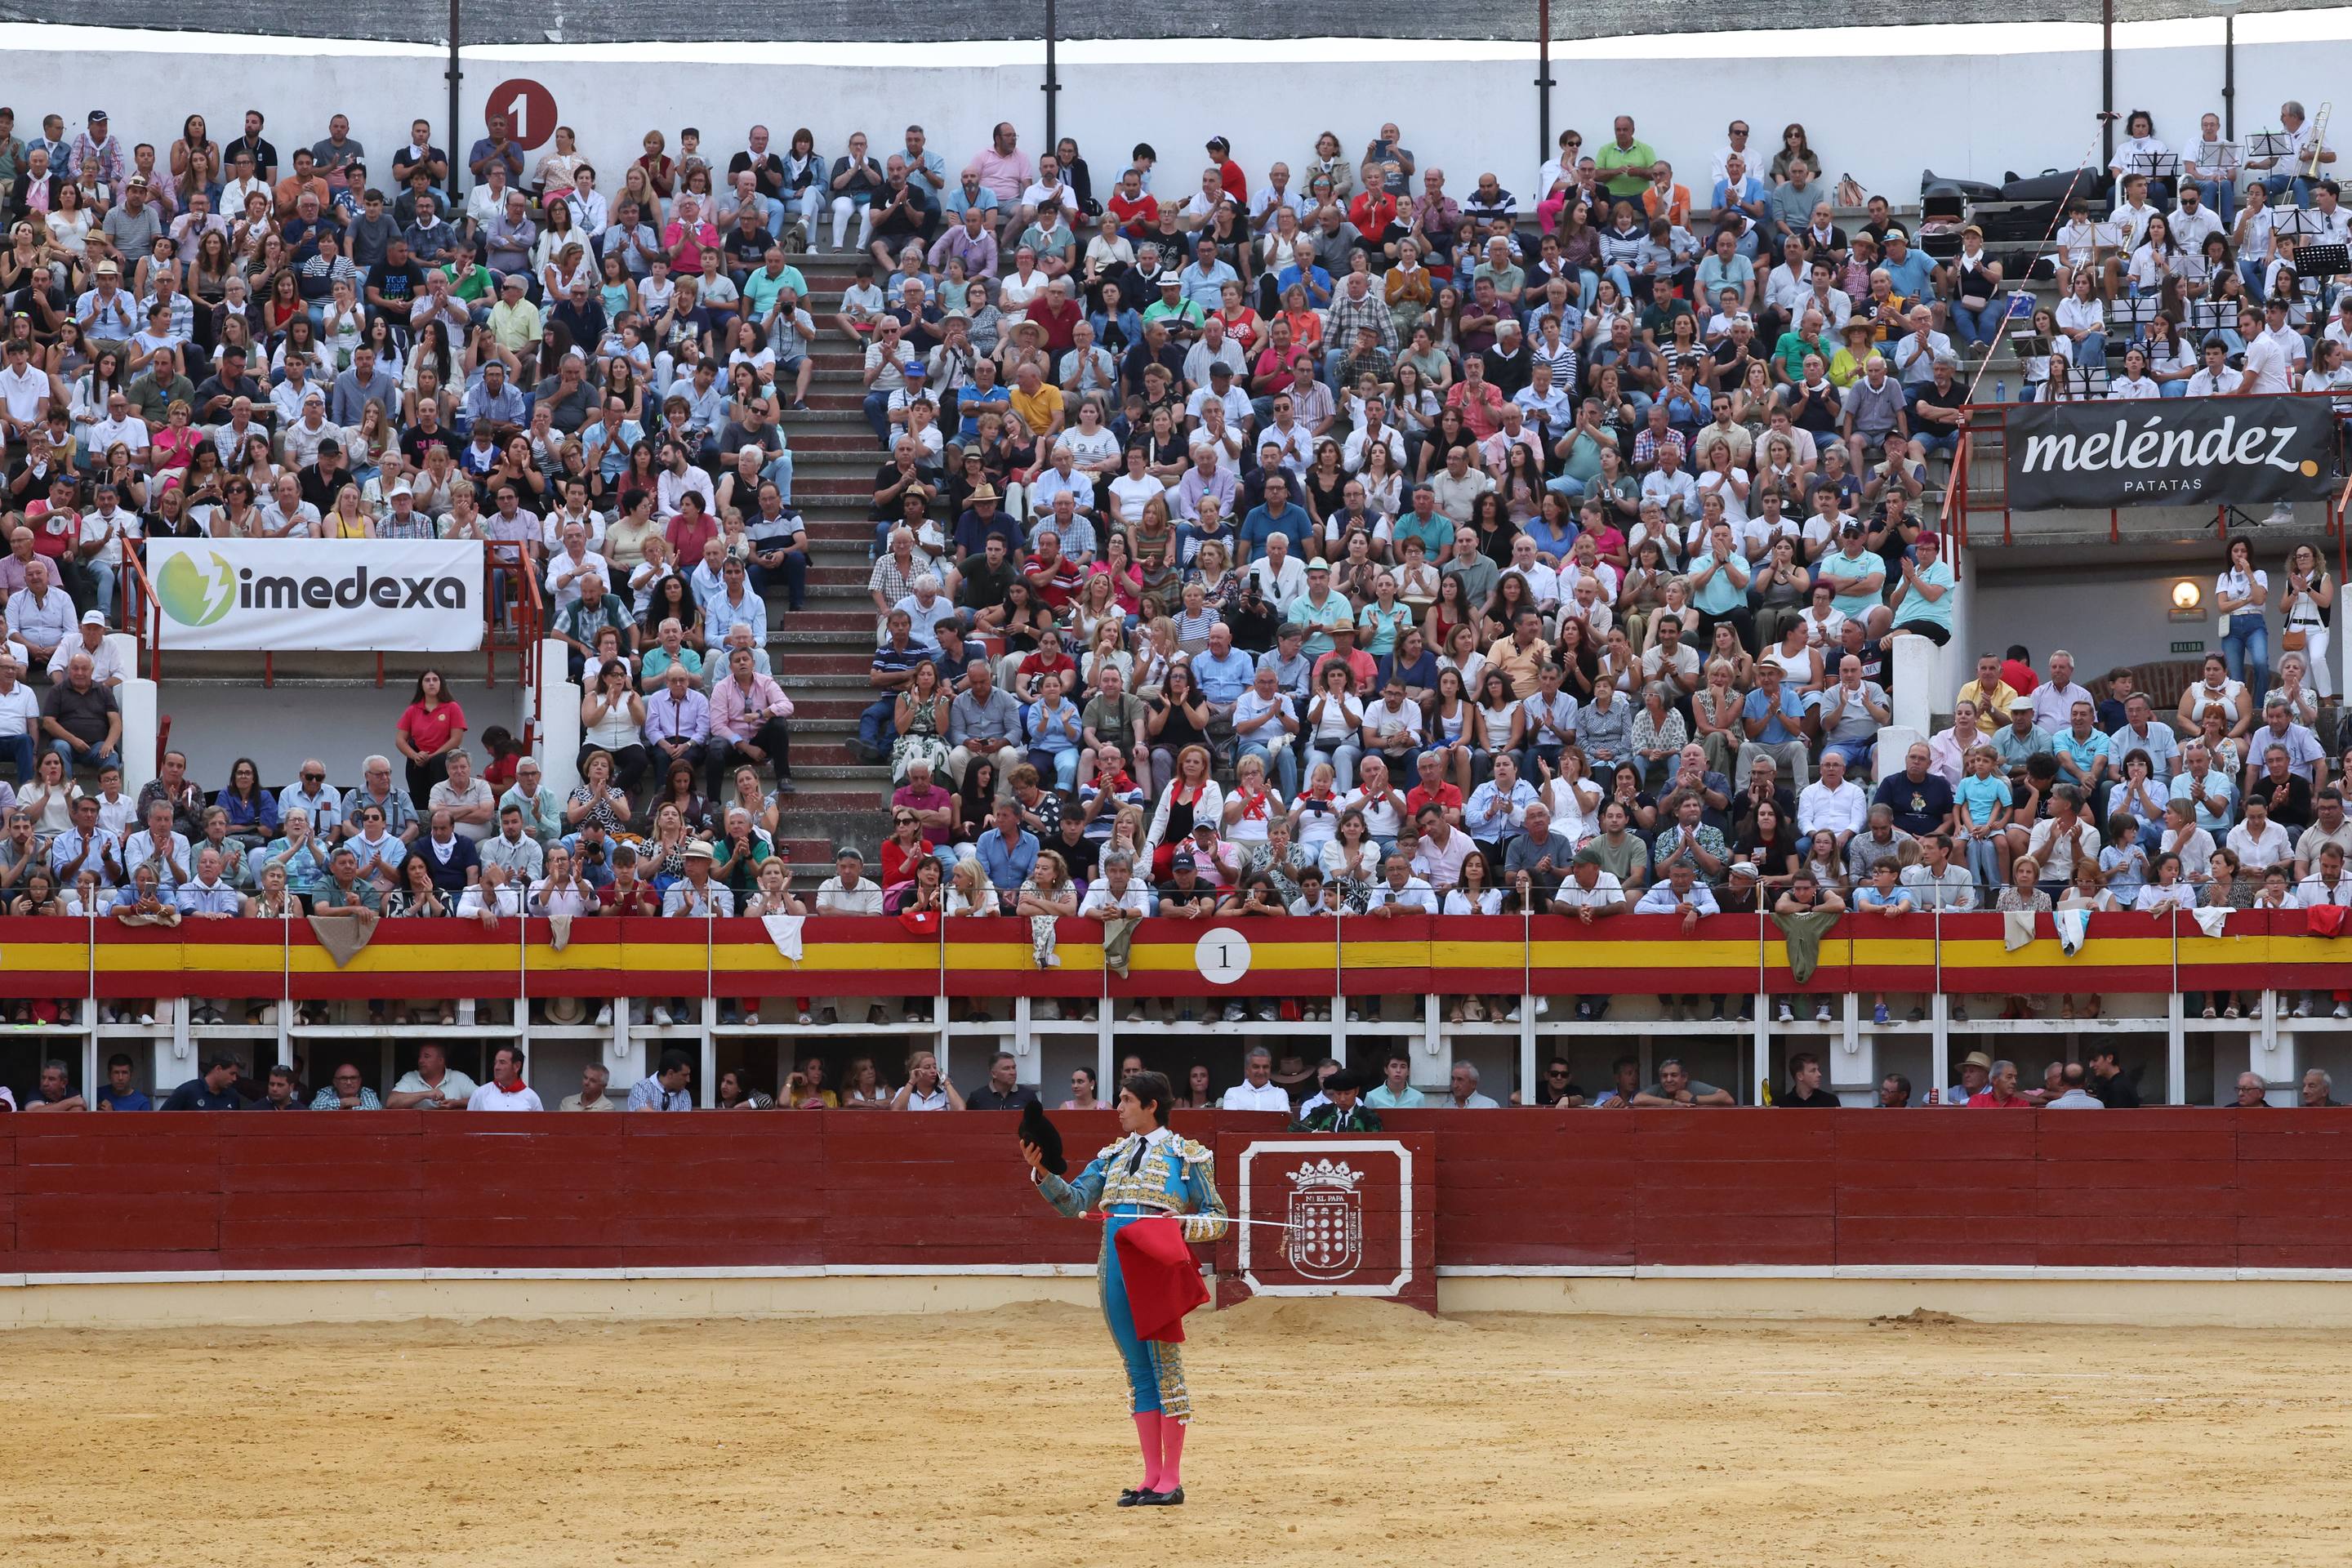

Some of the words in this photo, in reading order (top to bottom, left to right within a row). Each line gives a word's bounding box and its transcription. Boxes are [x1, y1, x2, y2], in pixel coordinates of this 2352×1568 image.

[508, 93, 527, 138] 1
[385, 275, 408, 283] YOUR
[2124, 479, 2202, 492] PATATAS
[239, 565, 466, 609] imedexa
[2173, 642, 2202, 652] SALIDA
[1218, 944, 1232, 969] 1
